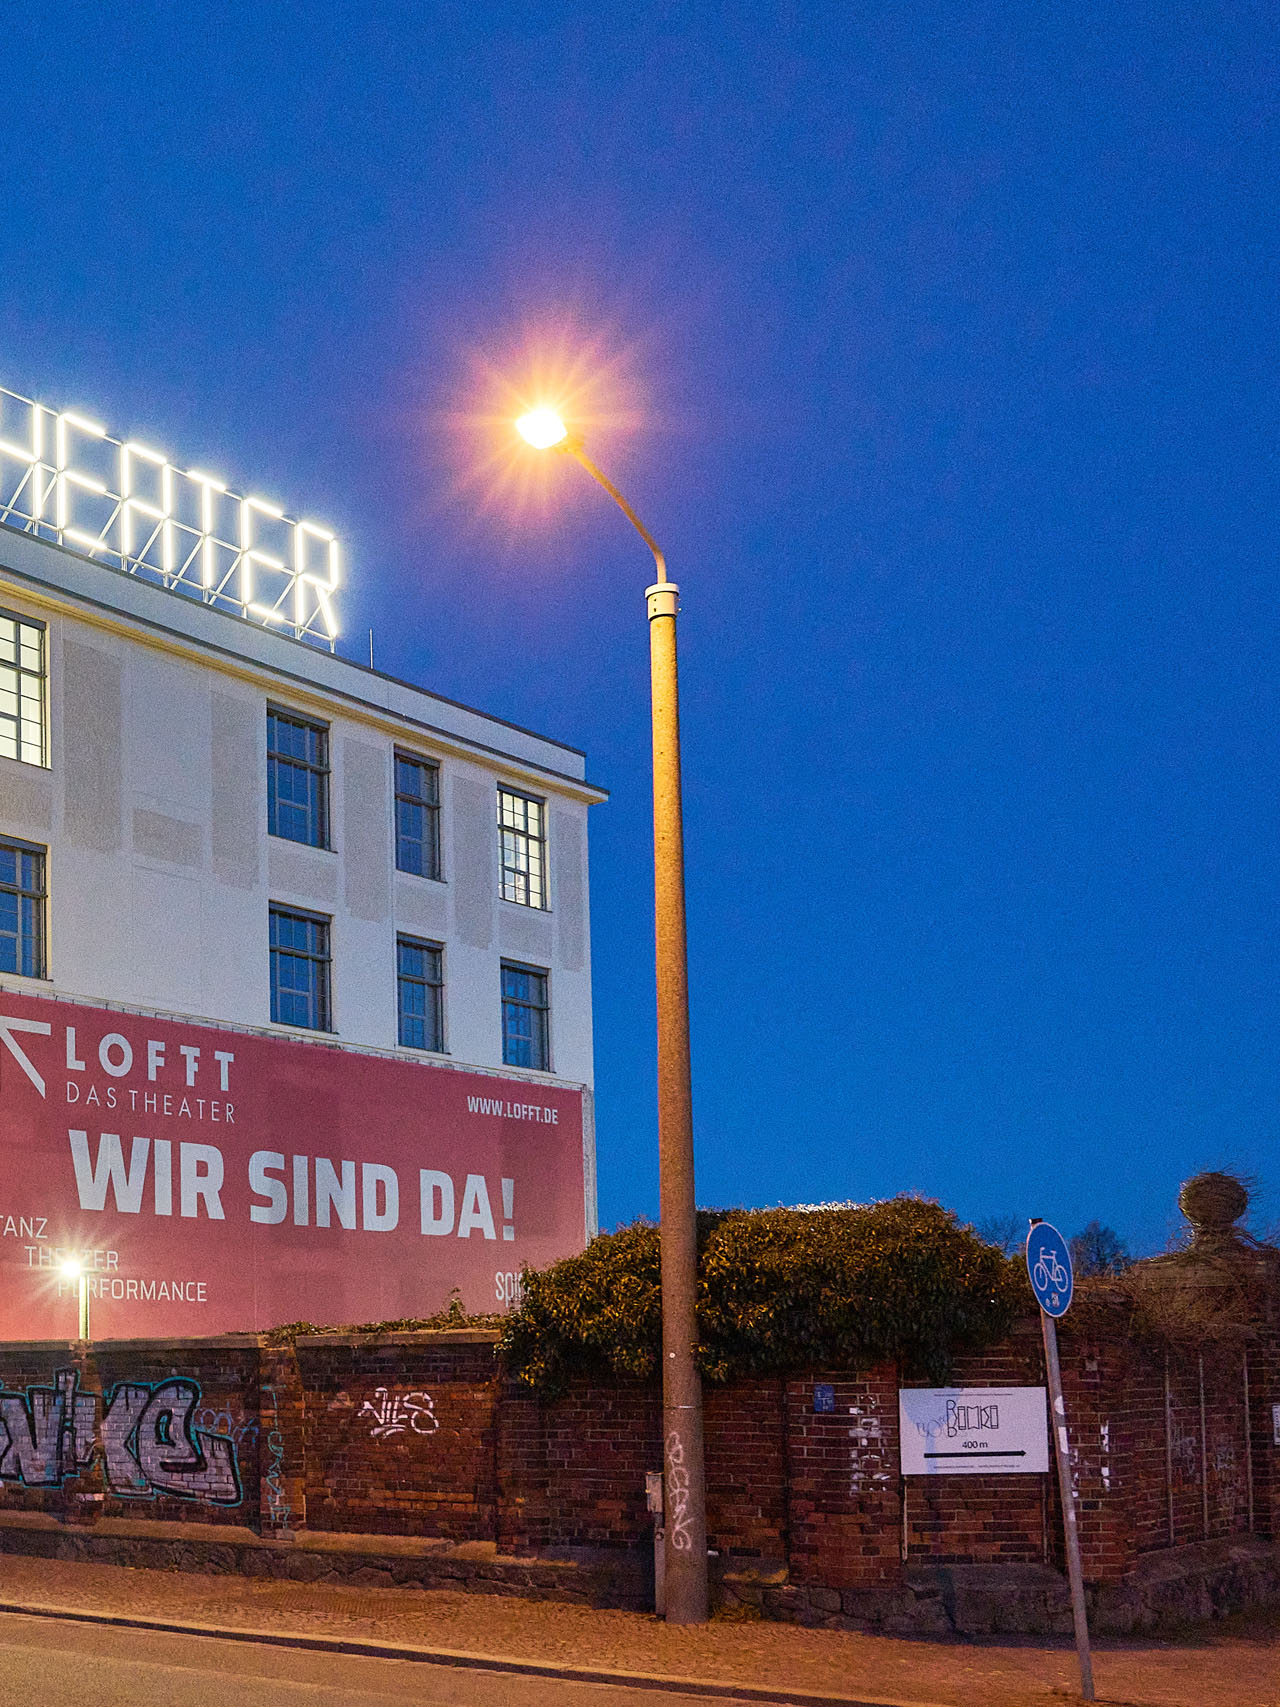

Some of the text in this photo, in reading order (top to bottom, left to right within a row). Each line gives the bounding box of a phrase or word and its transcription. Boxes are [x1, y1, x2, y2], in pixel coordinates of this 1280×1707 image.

[128, 1090, 236, 1124] THEATER
[467, 1095, 559, 1125] WWW.LOFFT.DE
[68, 1129, 516, 1241] WIR SIND DA!
[24, 1246, 120, 1272] THETER
[962, 1440, 978, 1449] 400
